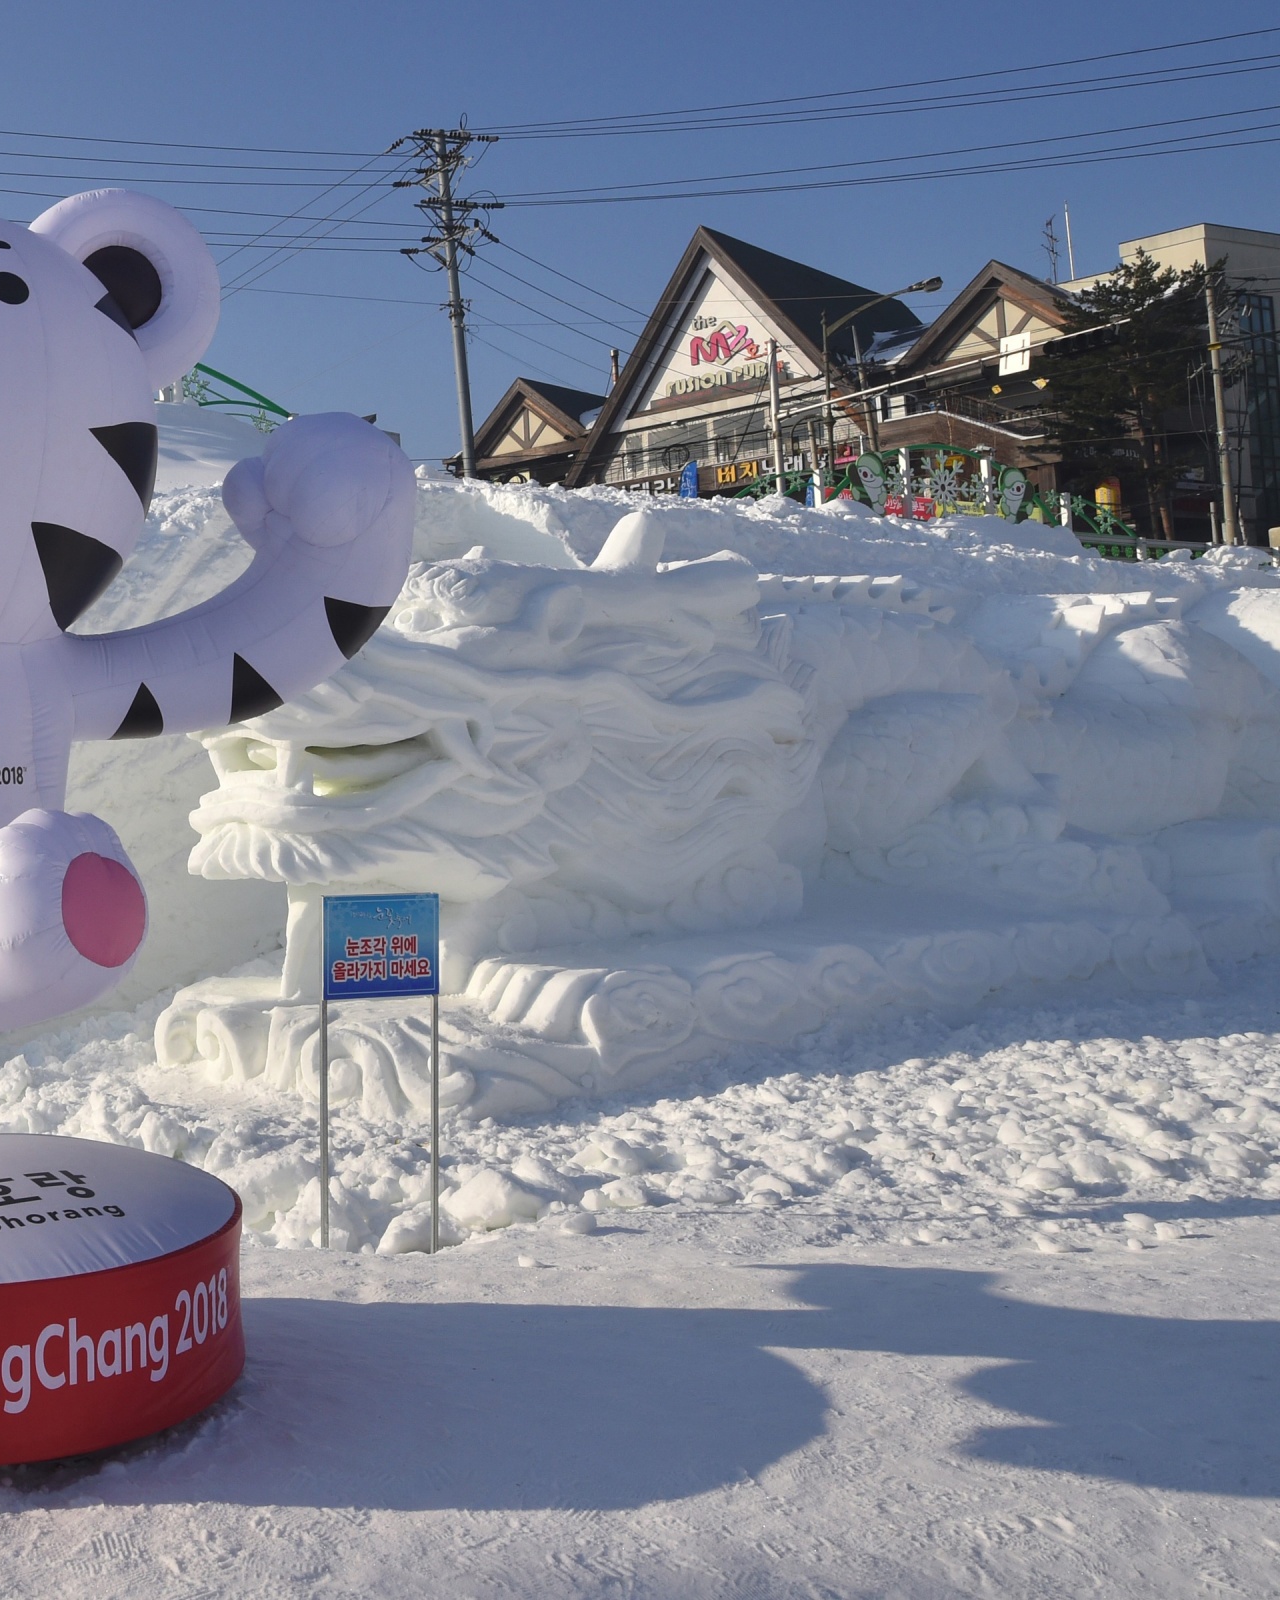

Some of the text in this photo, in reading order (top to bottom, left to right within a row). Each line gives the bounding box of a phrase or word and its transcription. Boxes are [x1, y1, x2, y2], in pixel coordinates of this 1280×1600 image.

[691, 315, 717, 331] the
[731, 362, 768, 383] PUB
[345, 935, 417, 957] 눈조각 위에
[332, 958, 431, 981] 올라가지 마세요
[175, 1267, 228, 1355] 2018
